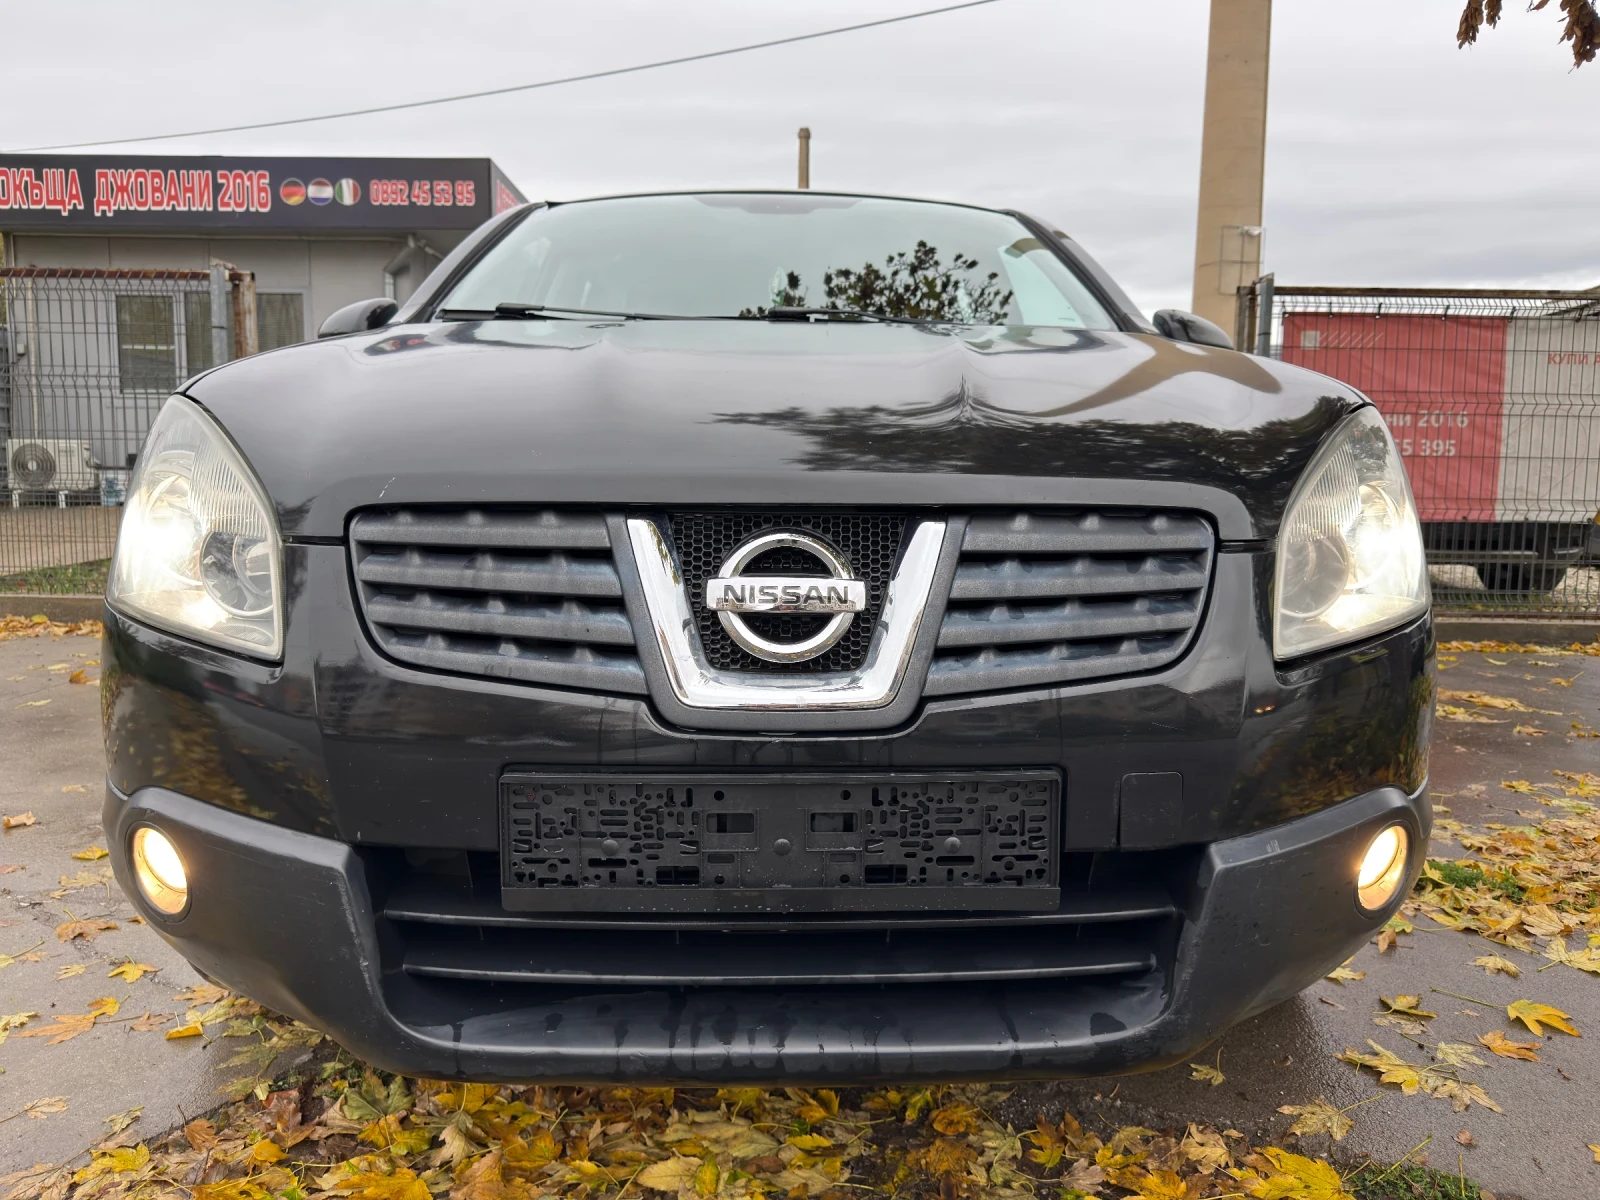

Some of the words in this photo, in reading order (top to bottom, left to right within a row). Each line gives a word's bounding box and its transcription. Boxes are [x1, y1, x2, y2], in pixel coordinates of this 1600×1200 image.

[94, 168, 213, 216] ДЖОВАНИ
[217, 170, 271, 212] 2016
[370, 179, 408, 206] 0892
[411, 180, 430, 206] 45
[433, 180, 453, 206] 53
[454, 180, 475, 206] 95
[1548, 353, 1589, 365] КУПИ
[1417, 409, 1469, 428] 2016
[1419, 439, 1456, 457] 395
[723, 584, 849, 605] NISSAN
